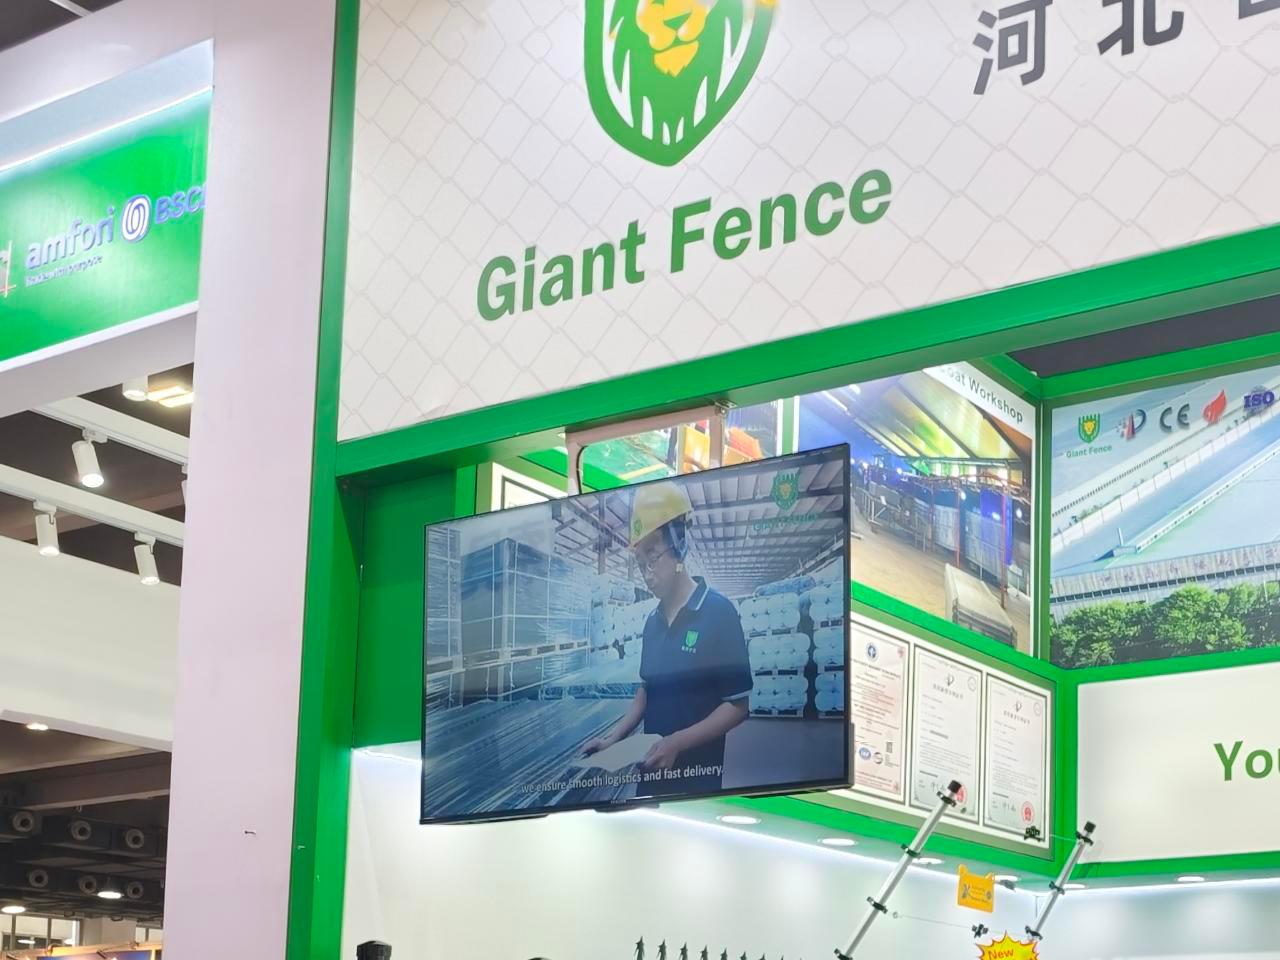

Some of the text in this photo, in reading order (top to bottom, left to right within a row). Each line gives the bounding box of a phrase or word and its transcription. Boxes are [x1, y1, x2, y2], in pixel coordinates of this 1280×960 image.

[25, 206, 115, 270] amfori
[476, 168, 892, 322] Giant Fence
[940, 366, 1024, 424] oat Workshop
[1243, 391, 1275, 410] ISO
[1160, 402, 1190, 433] CE
[1066, 443, 1113, 459] Giant Fence
[536, 781, 567, 793] ensure
[567, 774, 603, 792] smooth
[604, 772, 642, 787] logistics
[643, 769, 662, 782] and
[663, 768, 682, 780] fast
[683, 764, 724, 779] delivery.
[988, 949, 1014, 960] New
